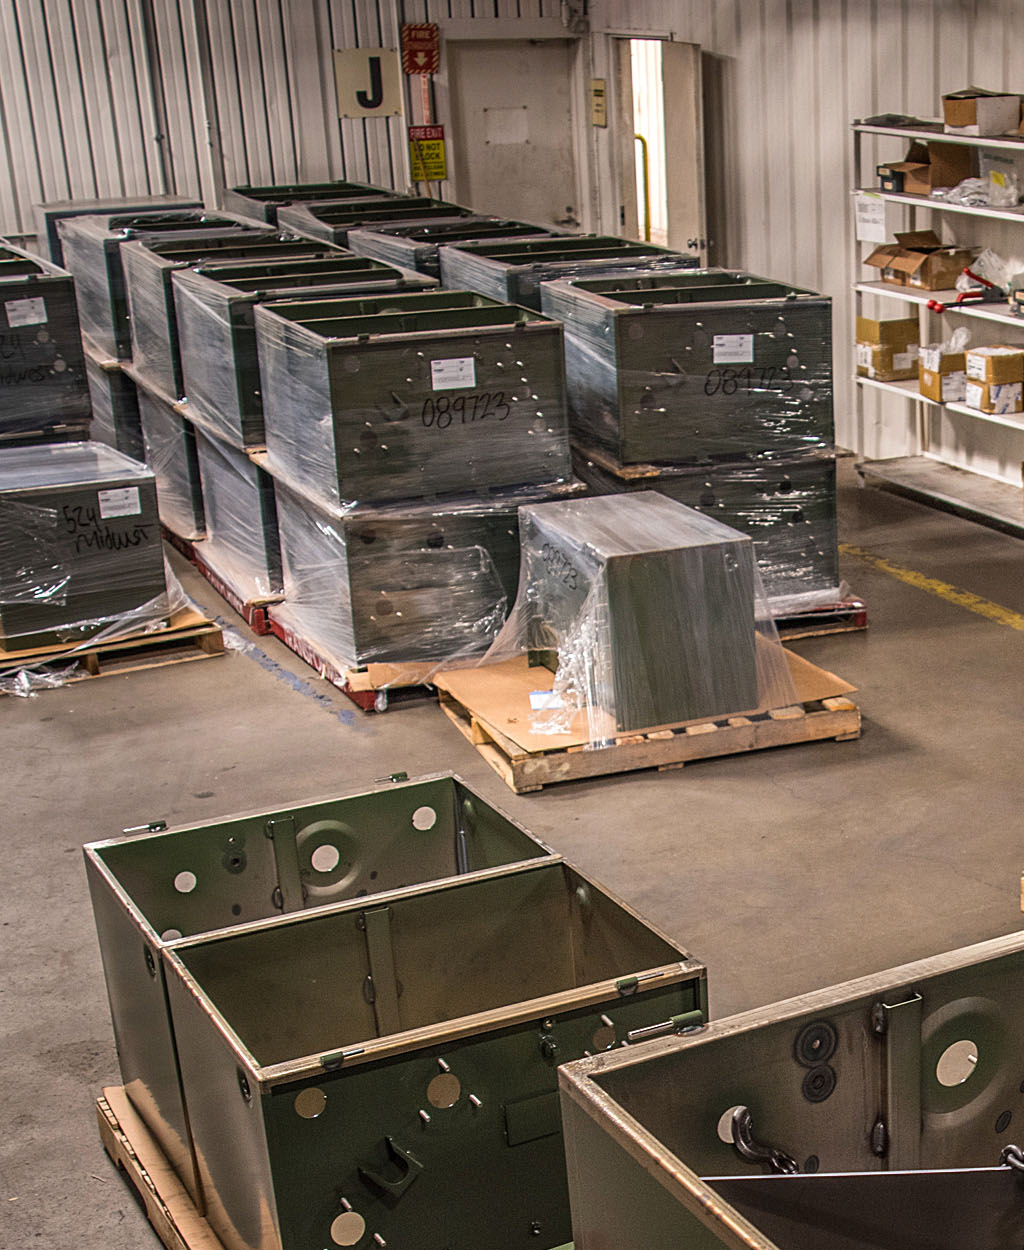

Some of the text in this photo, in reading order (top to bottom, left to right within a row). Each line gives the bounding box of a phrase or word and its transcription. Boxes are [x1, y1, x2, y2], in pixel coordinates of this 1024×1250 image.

[355, 55, 384, 110] J
[410, 127, 443, 138] FIRE EXIT
[426, 143, 441, 151] NOT
[421, 391, 511, 429] 089723
[63, 505, 101, 534] 524
